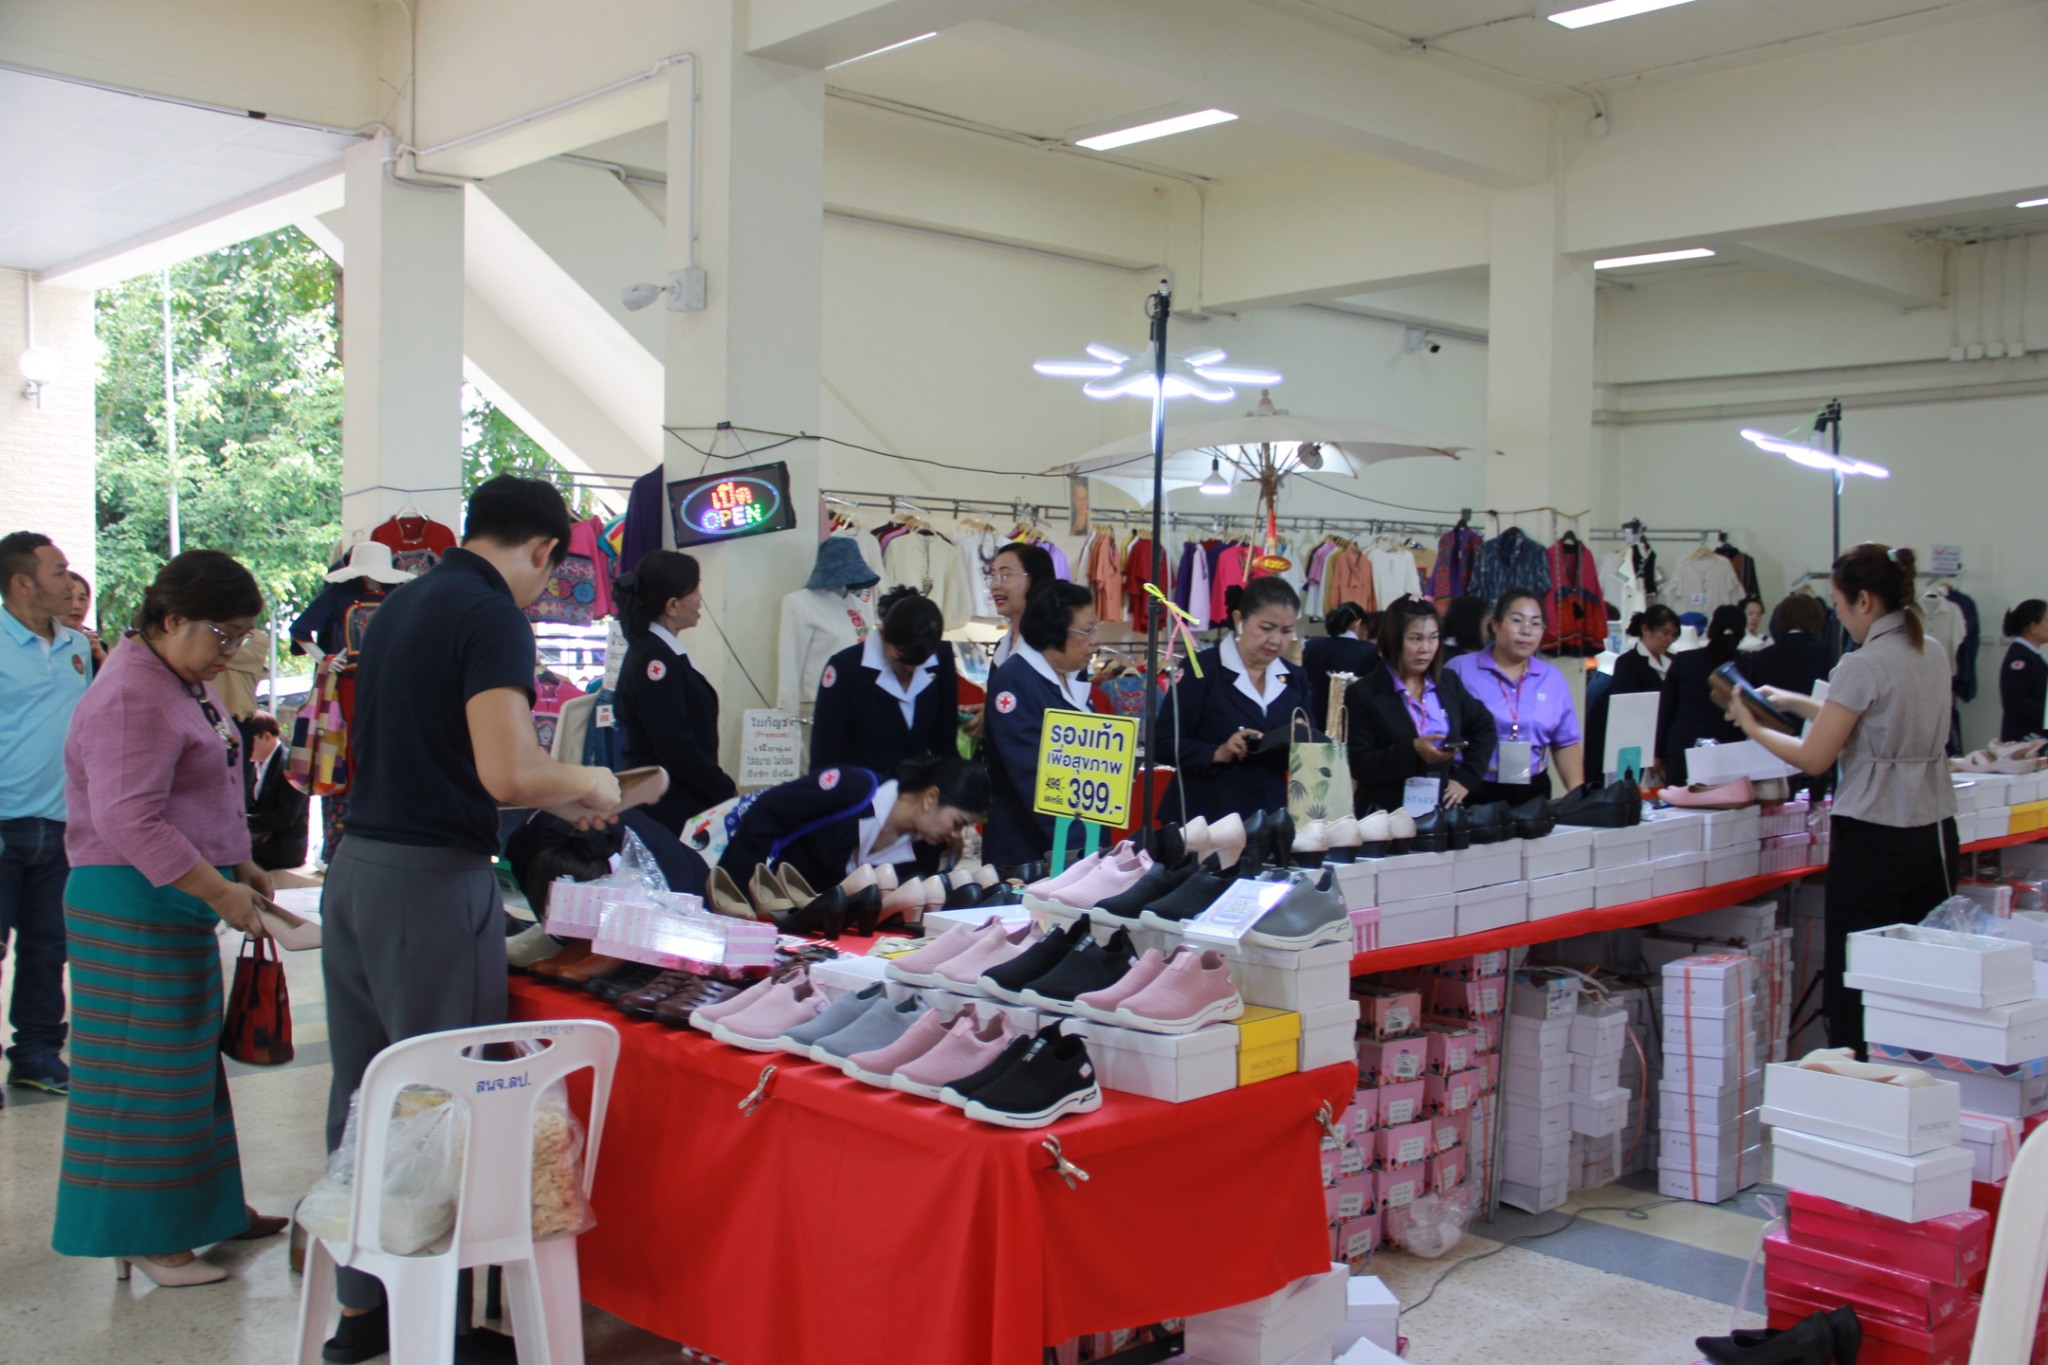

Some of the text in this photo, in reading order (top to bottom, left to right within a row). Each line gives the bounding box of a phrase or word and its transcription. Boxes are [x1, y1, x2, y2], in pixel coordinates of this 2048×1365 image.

[711, 482, 753, 509] เปิด
[702, 504, 763, 529] OPEN
[1051, 723, 1124, 752] รองเท้า
[1047, 744, 1123, 775] เพื่อสุขภาพ
[1068, 777, 1123, 815] 399.-
[476, 1071, 532, 1093] สนจ.ลป.
